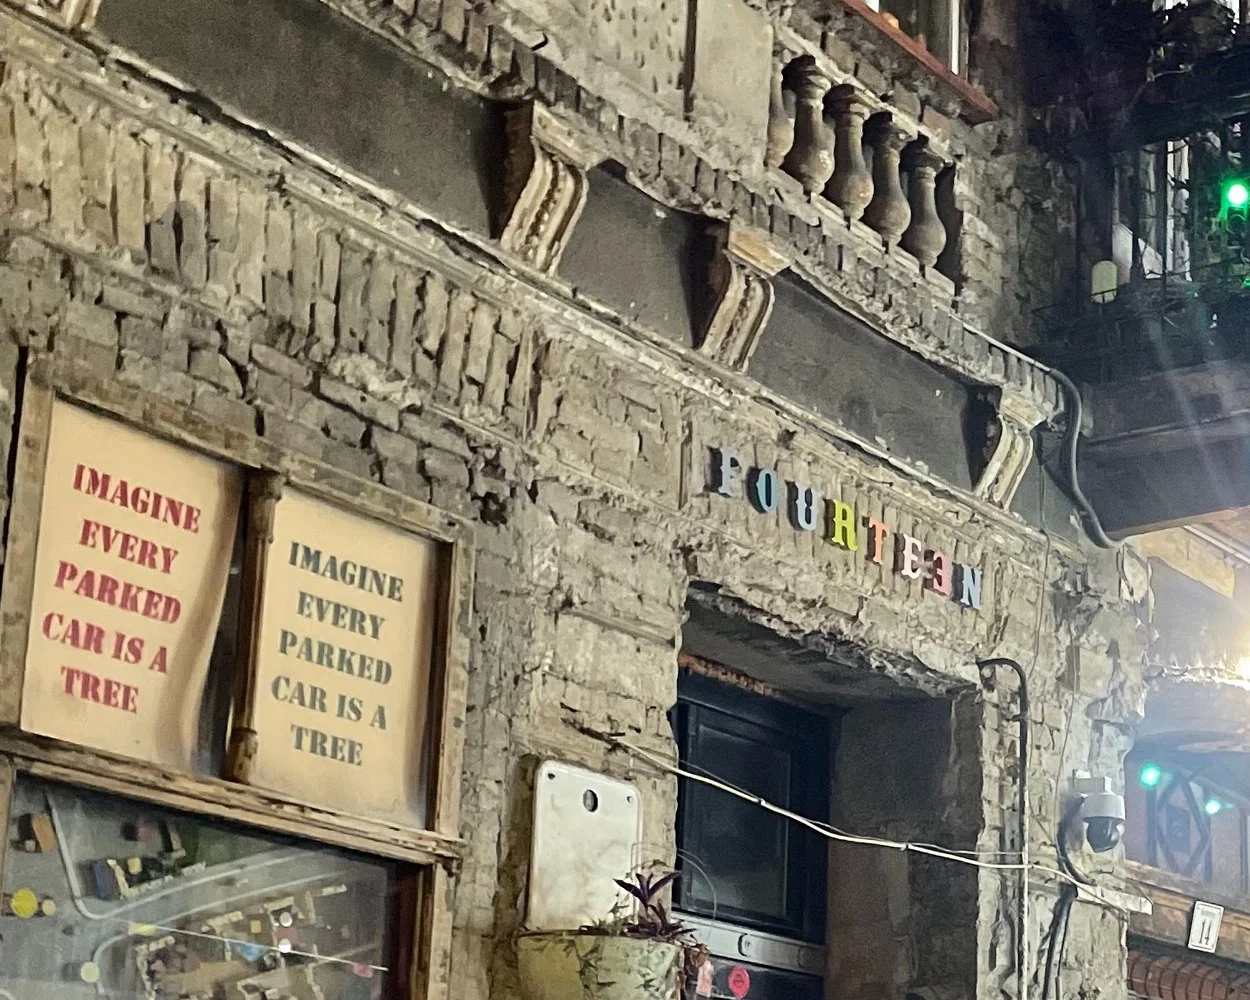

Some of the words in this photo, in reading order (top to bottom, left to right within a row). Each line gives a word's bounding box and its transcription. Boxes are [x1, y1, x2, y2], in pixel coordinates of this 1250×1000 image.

[73, 464, 201, 534] IMAGINE
[78, 518, 179, 576] EVERY
[288, 541, 404, 603] IMAGINE
[54, 560, 182, 625] PARKED
[296, 590, 386, 641] EVERY
[42, 612, 107, 656] CAR
[112, 631, 146, 666] IS
[149, 645, 169, 674] A
[278, 629, 393, 686] PARKED
[60, 666, 139, 715] TREE
[270, 676, 328, 713] CAR
[336, 694, 364, 722] IS
[370, 705, 388, 731] A
[290, 724, 364, 767] TREE
